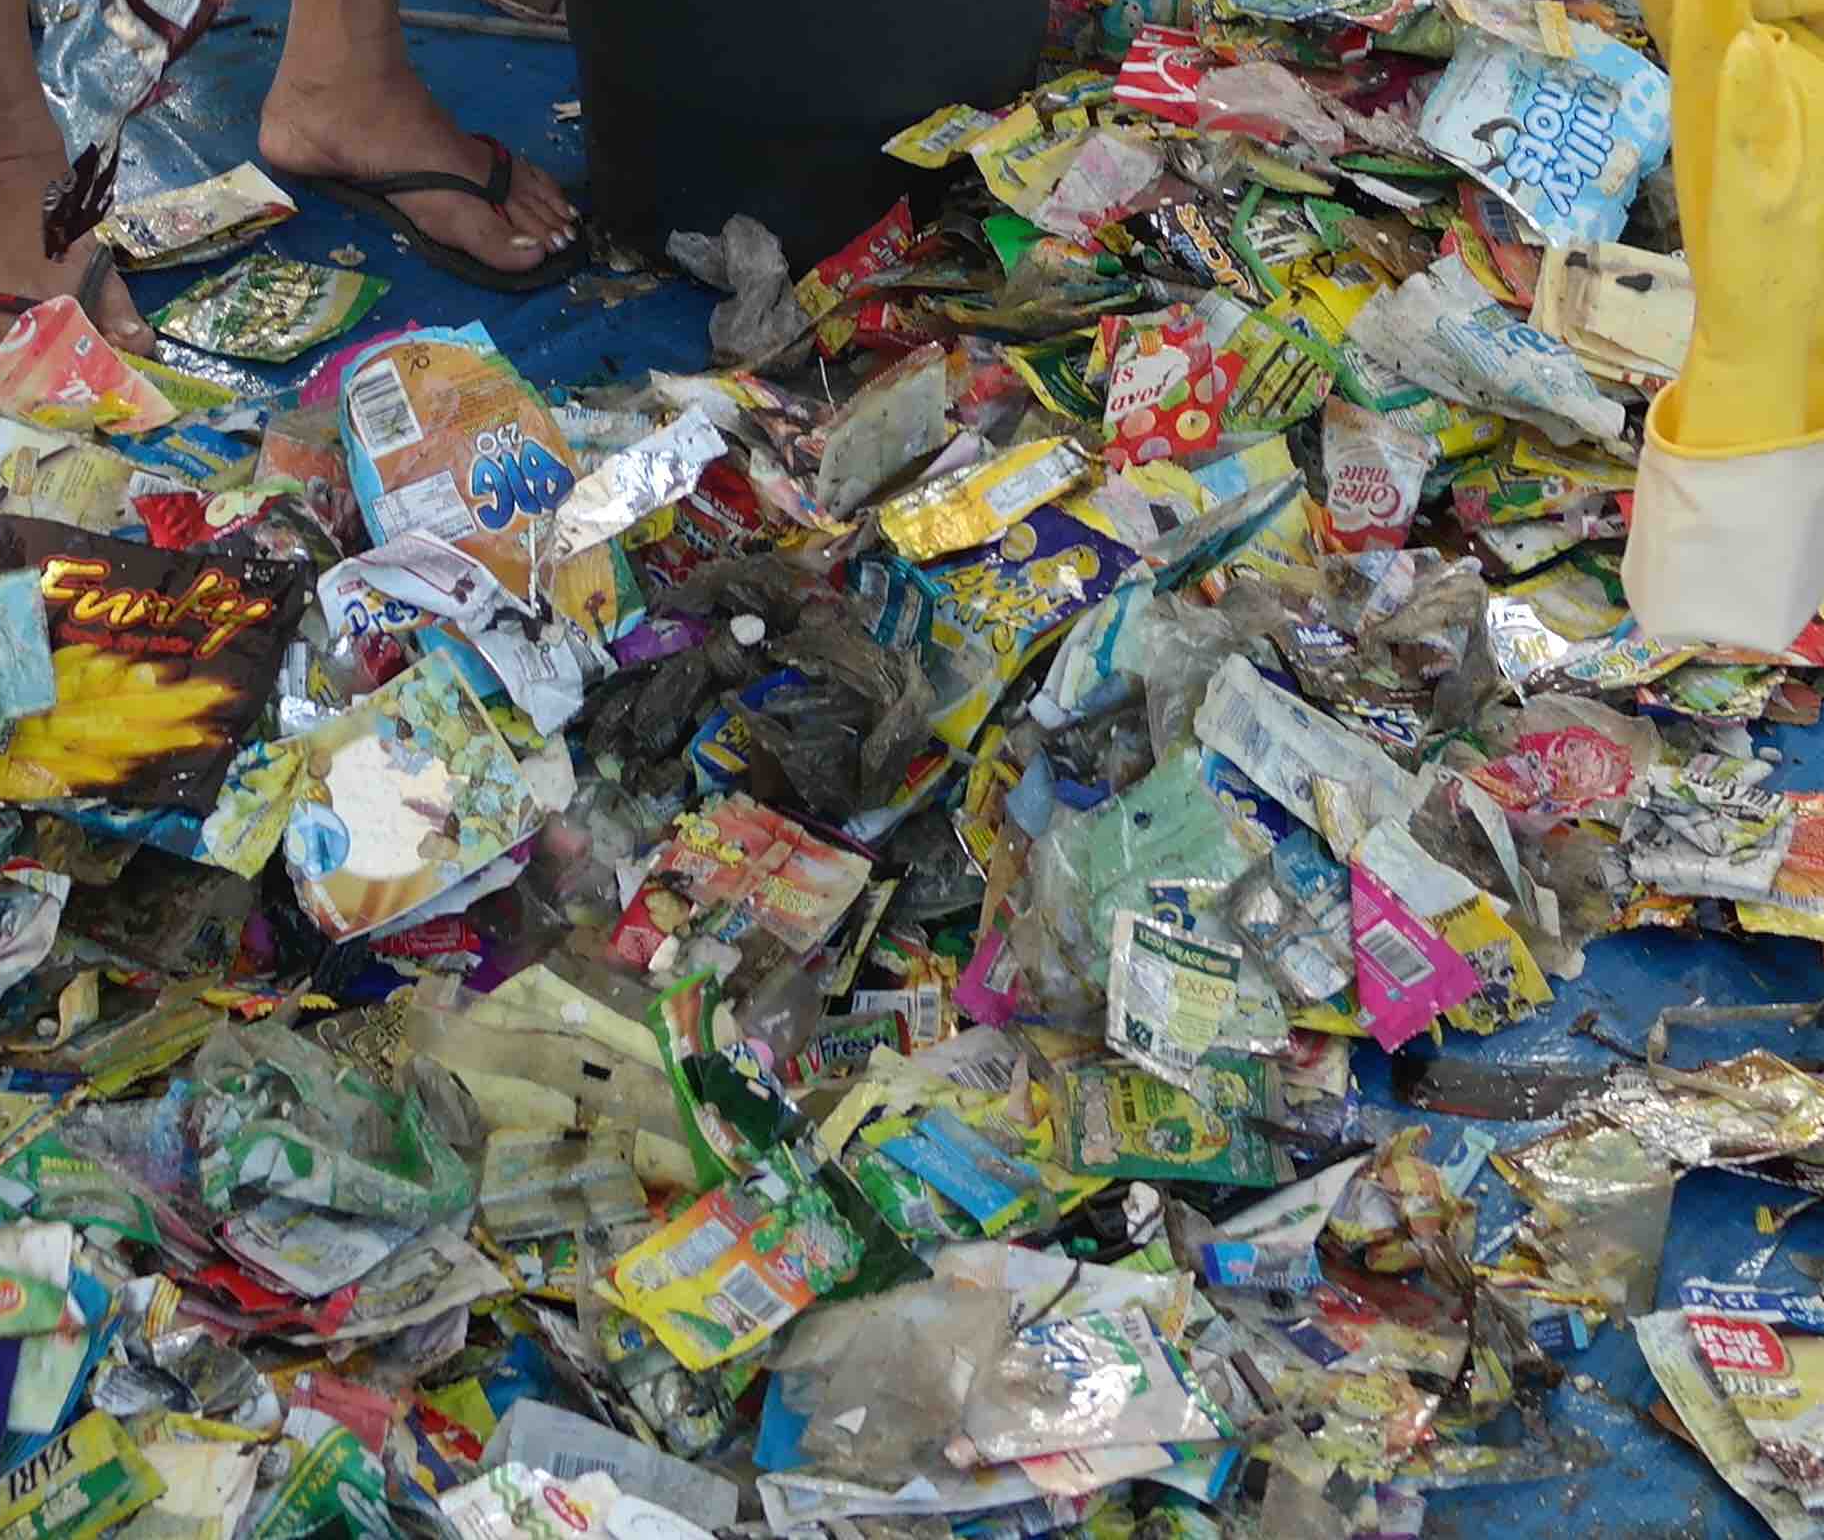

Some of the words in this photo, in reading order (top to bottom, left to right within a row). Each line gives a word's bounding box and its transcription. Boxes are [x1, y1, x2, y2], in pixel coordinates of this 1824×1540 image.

[471, 436, 577, 534] BIG
[1336, 461, 1390, 482] mate
[1330, 482, 1402, 524] Coffee
[1688, 1288, 1759, 1309] PACK
